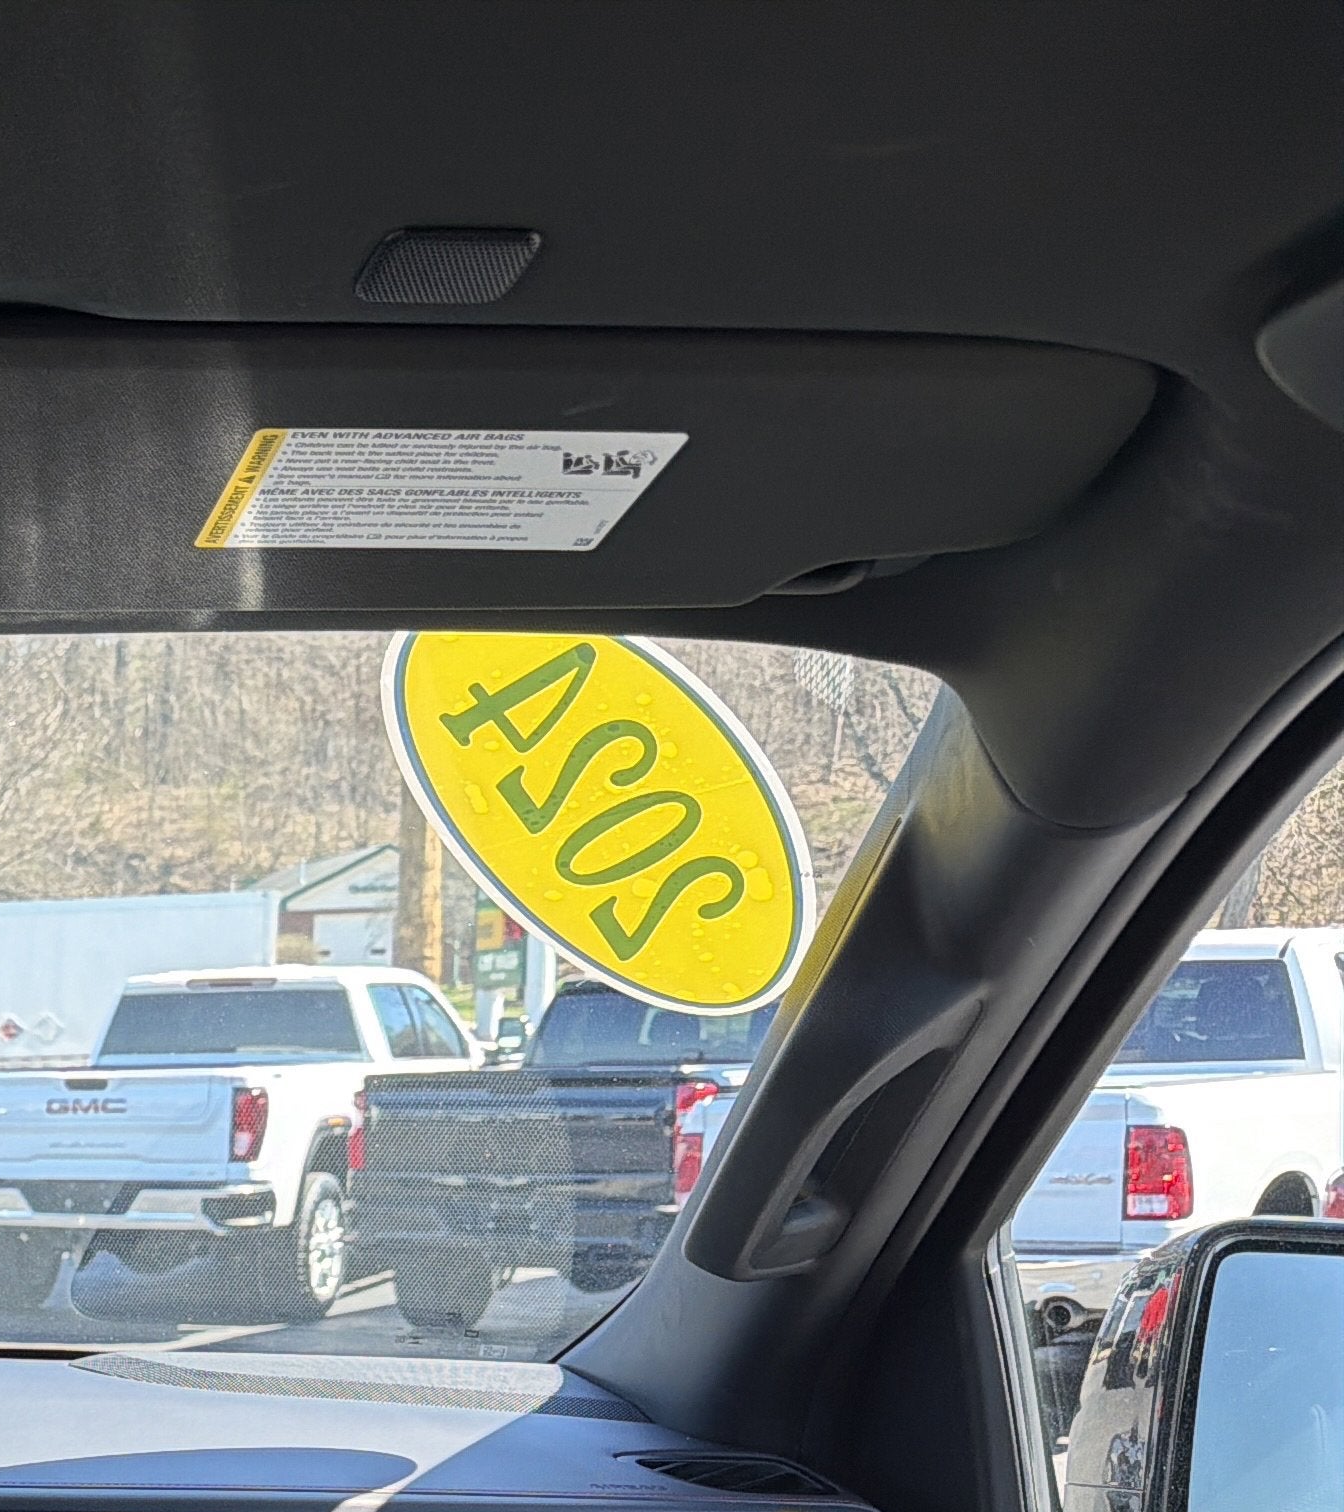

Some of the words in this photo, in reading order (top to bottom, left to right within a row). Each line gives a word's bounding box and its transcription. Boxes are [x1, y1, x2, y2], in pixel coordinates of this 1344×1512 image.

[290, 431, 330, 440] EVEN
[332, 432, 369, 440] WITH
[371, 432, 452, 441] ADVANCED
[454, 433, 481, 441] AIR
[483, 433, 525, 441] BAGS
[246, 434, 279, 472] WARNING
[300, 488, 337, 496] AVEC
[339, 488, 365, 496] DES
[366, 488, 402, 497] SACS
[404, 489, 489, 498] GONFLABLES
[490, 490, 582, 499] INTELLIGENTS
[46, 1098, 127, 1114] GMC
